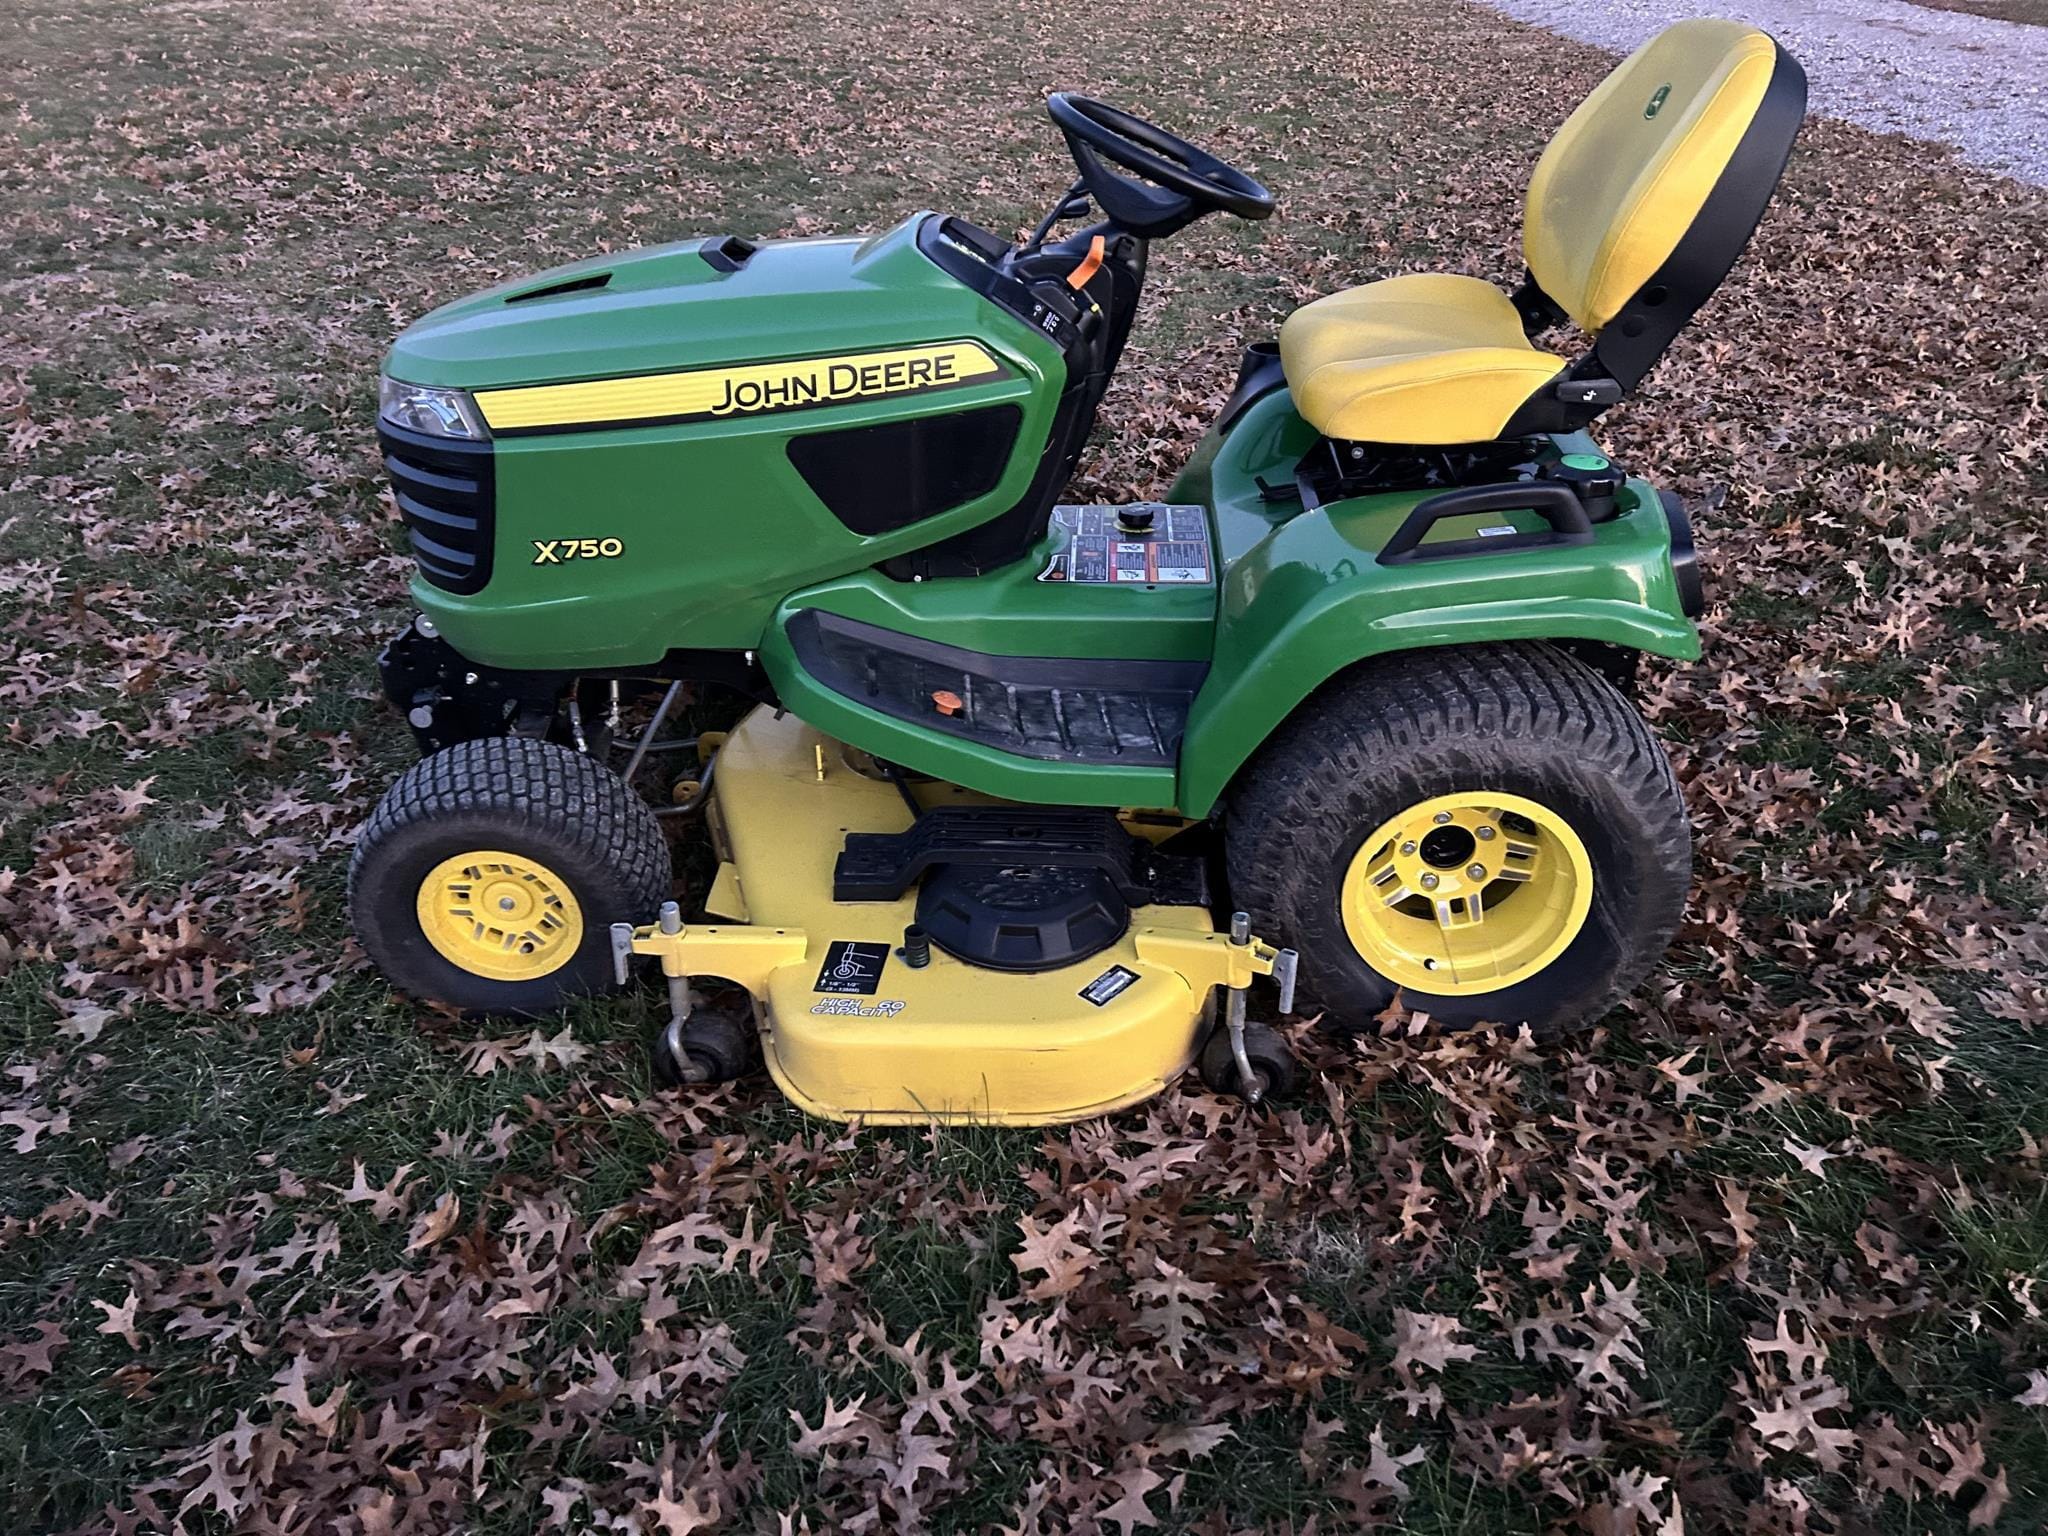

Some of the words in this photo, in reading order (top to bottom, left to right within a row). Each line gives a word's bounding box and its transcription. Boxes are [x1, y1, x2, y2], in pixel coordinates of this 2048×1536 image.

[712, 373, 817, 410] JOHN
[829, 354, 956, 395] DEERE
[532, 537, 624, 565] X750
[811, 1006, 900, 1017] CAPACITY
[820, 998, 863, 1007] HIGH
[878, 1000, 906, 1010] 60
